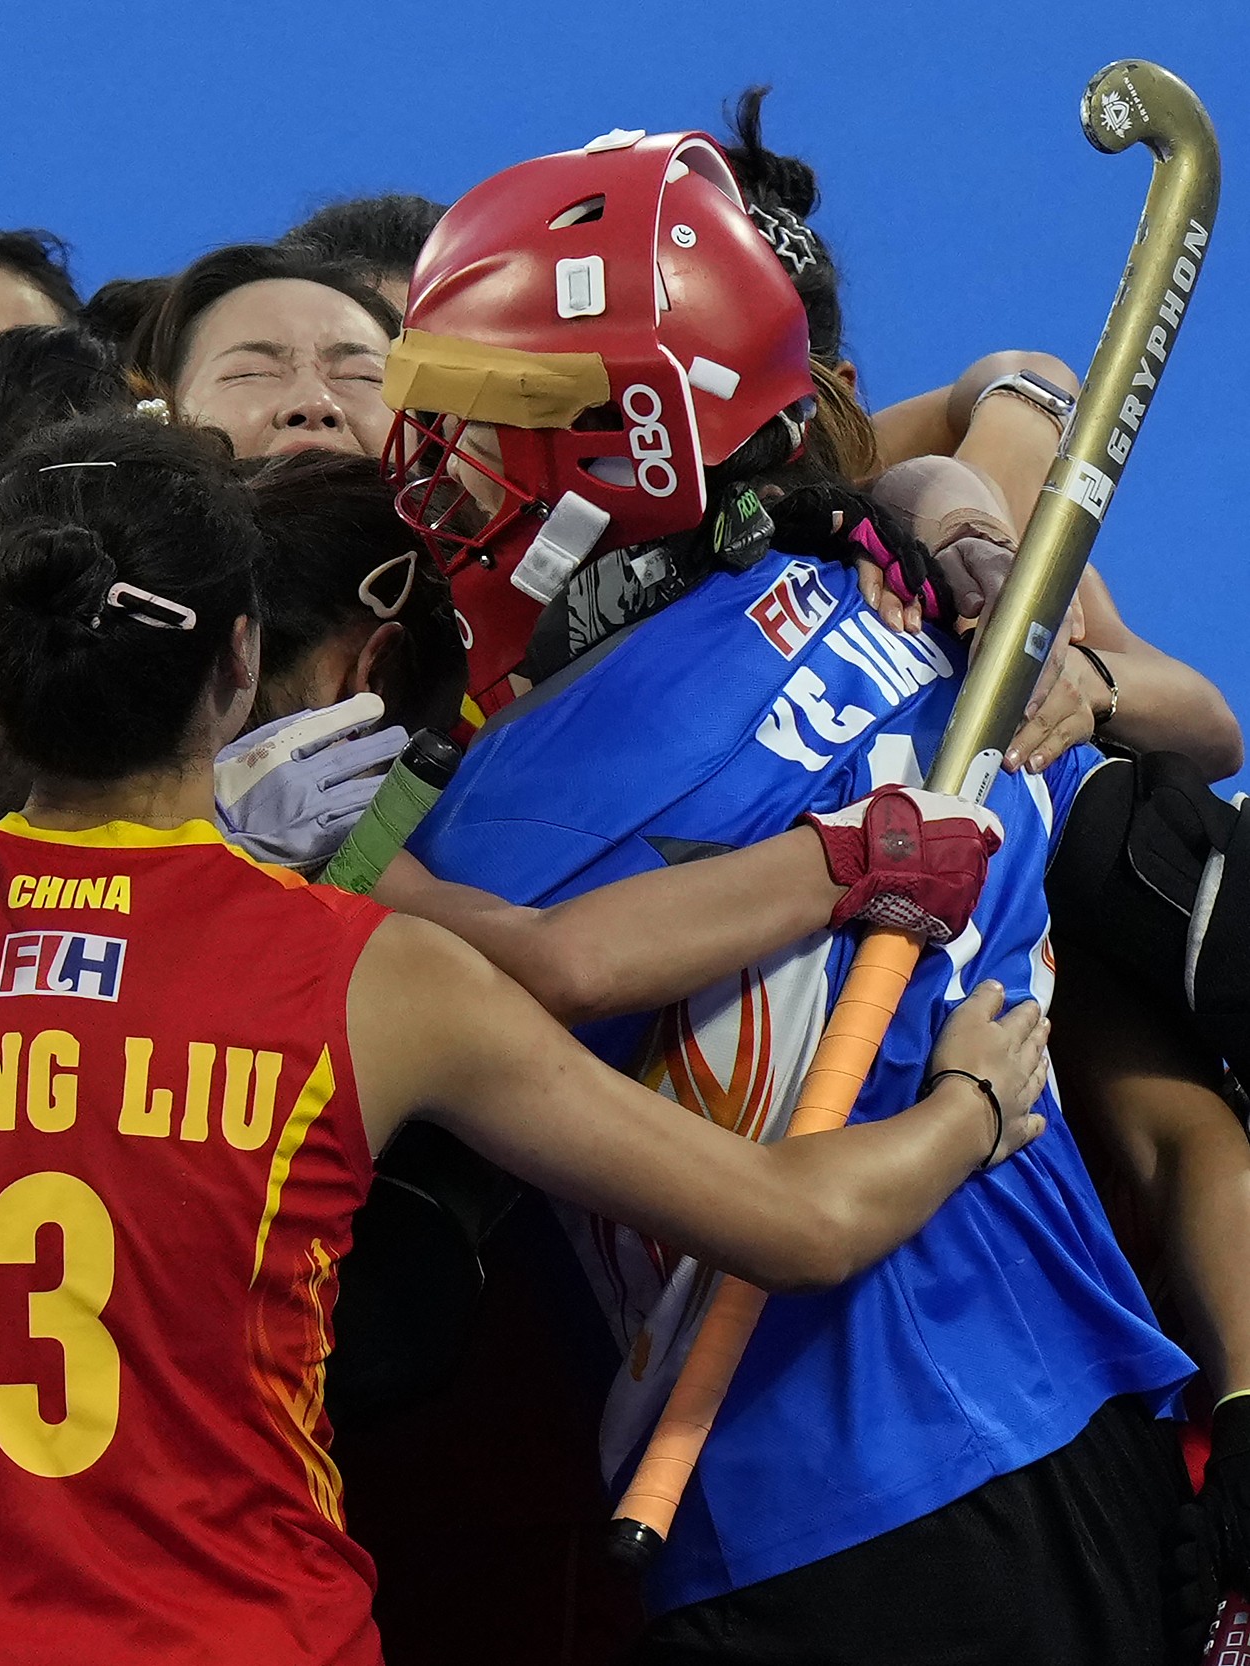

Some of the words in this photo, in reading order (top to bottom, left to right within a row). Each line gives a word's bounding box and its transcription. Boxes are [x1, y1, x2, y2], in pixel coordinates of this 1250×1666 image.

[1107, 219, 1209, 466] GRYPHON
[622, 383, 678, 498] OBO
[8, 874, 131, 914] CHINA
[117, 1036, 284, 1150] LIU
